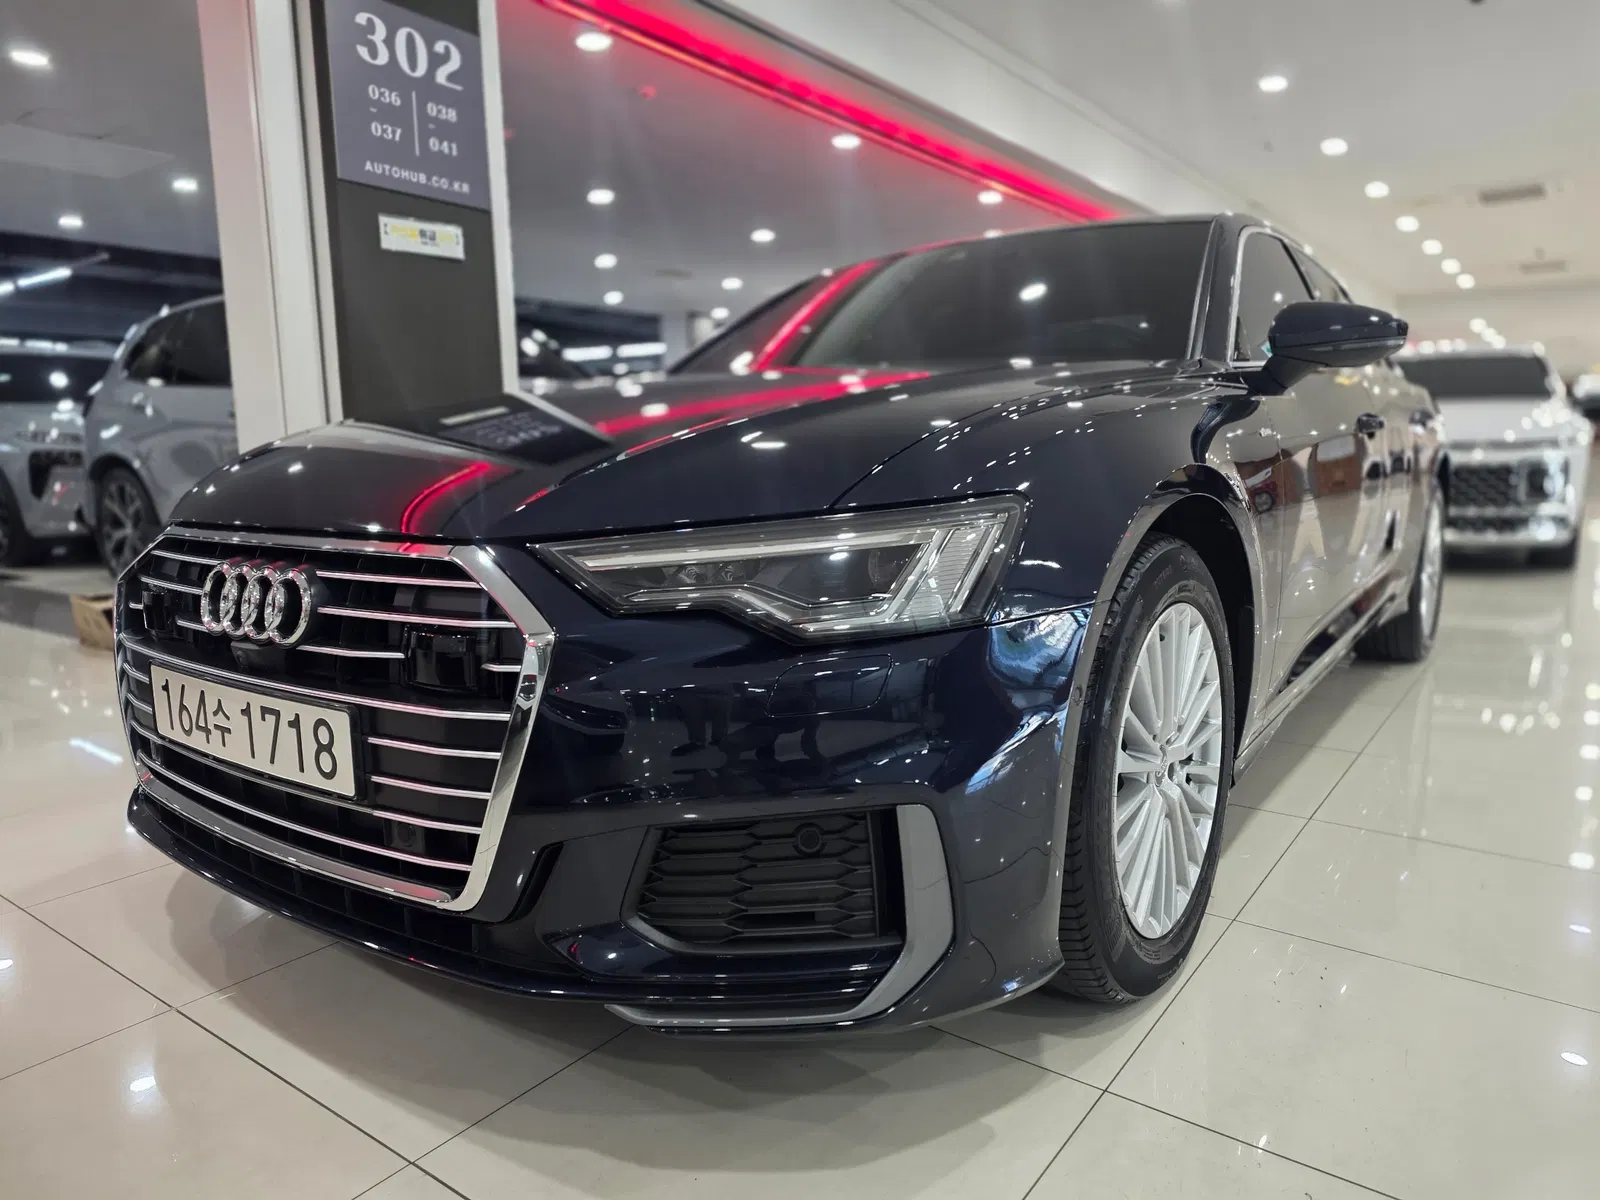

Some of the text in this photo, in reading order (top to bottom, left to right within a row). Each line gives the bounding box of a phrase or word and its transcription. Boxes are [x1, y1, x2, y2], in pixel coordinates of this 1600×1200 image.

[354, 12, 463, 90] 302
[368, 84, 401, 106] 036
[427, 102, 458, 123] 038
[371, 121, 402, 142] 037
[429, 137, 458, 156] 041
[364, 160, 470, 195] AUTOHUB.CO.KR
[161, 678, 338, 780] 164수1718
